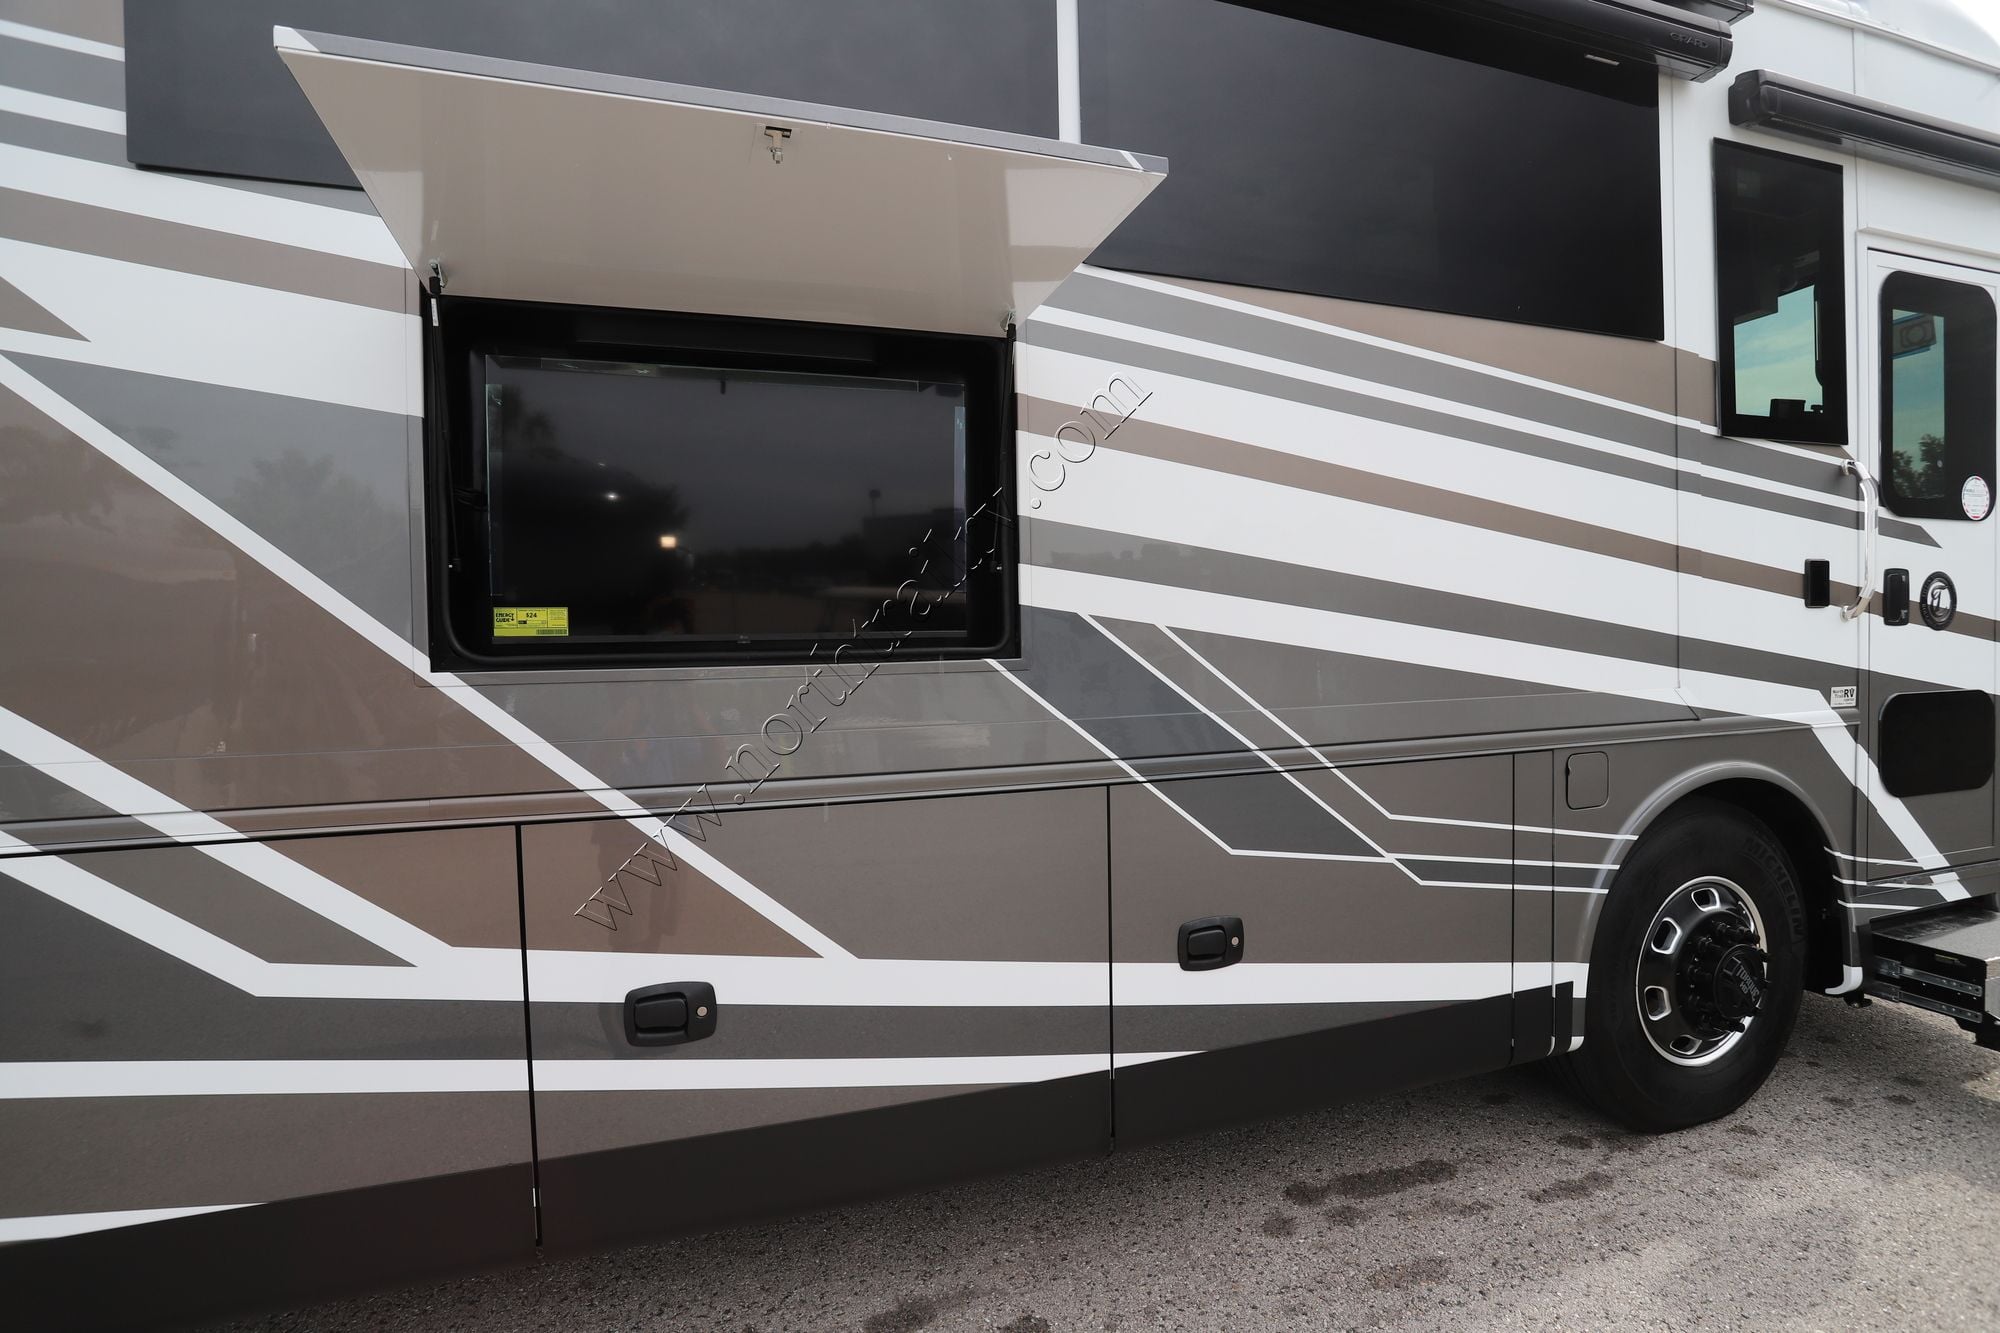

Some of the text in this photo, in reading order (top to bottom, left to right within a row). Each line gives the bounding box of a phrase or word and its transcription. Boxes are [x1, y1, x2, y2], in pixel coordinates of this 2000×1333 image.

[1670, 32, 1709, 49] GIRARD
[1844, 688, 1855, 698] RV
[1742, 834, 1807, 936] MICHELIN
[1736, 965, 1760, 1001] TORQUE
[1740, 981, 1749, 994] HD
